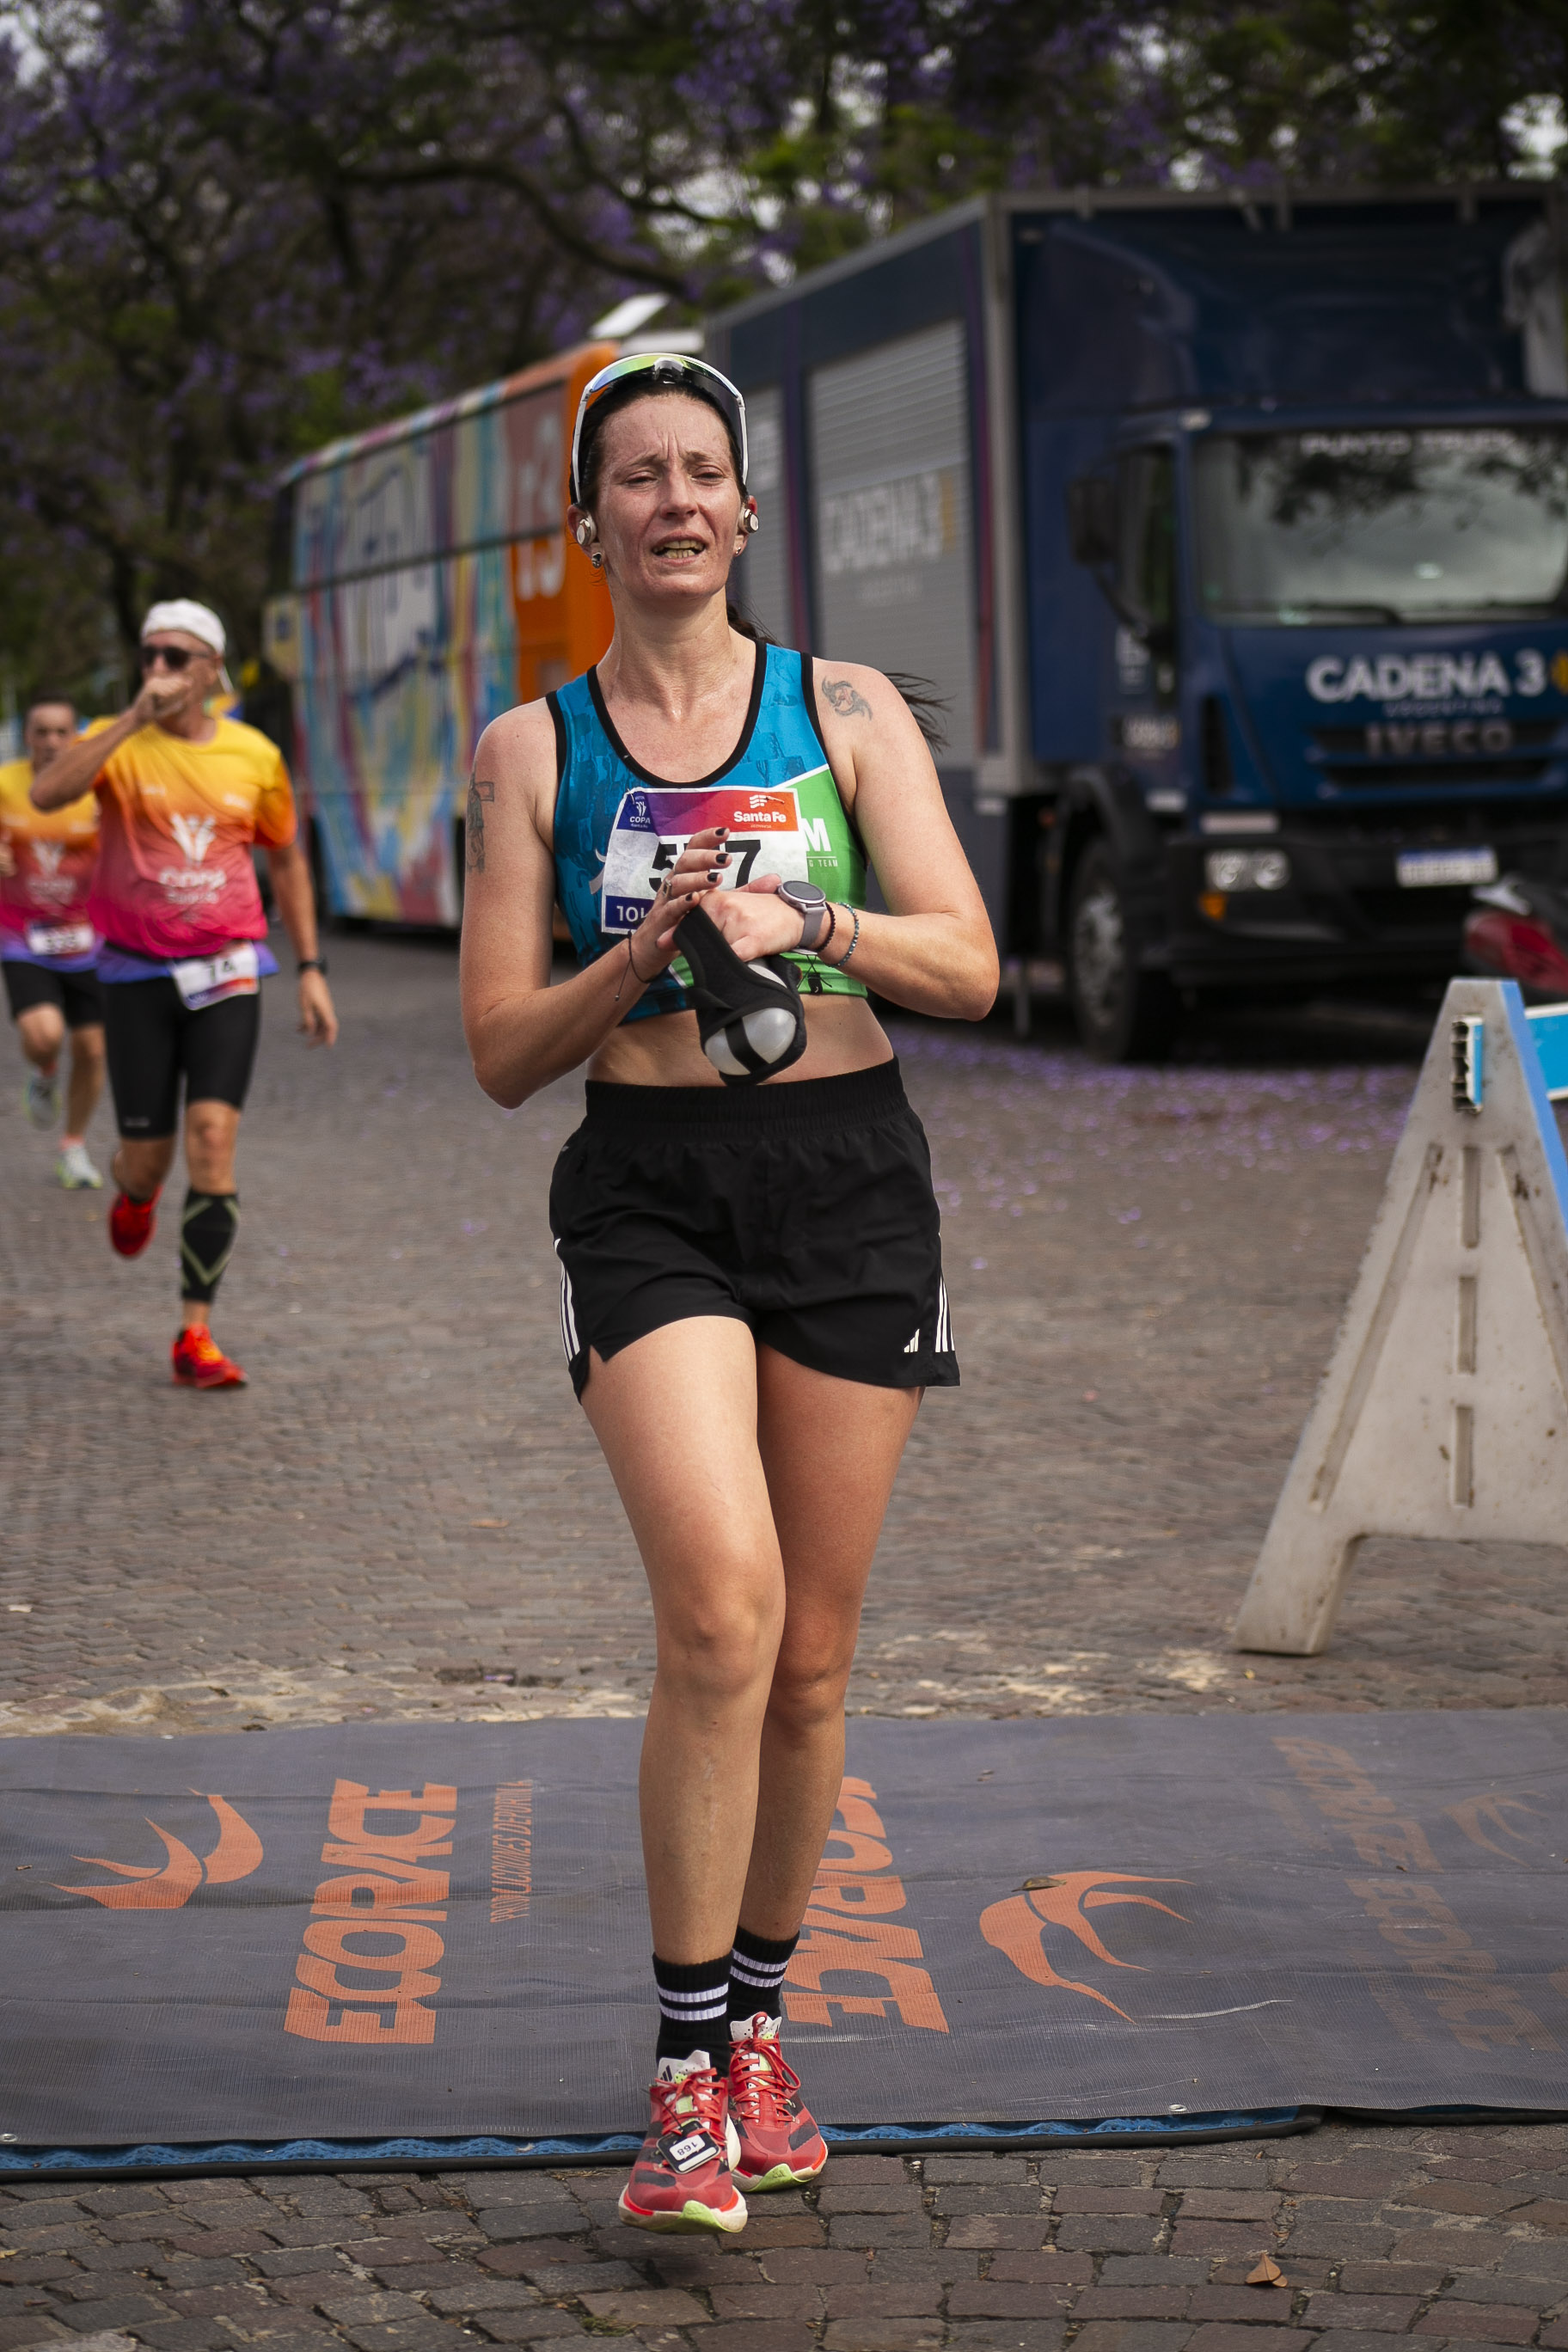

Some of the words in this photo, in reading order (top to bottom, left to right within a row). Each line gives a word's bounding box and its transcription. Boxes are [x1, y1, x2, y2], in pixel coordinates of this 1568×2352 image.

[1306, 652, 1511, 703] CADENA
[1515, 648, 1547, 697] 3
[1365, 720, 1513, 757] IVECO
[629, 816, 651, 824] COPA
[648, 839, 762, 893] 57
[284, 1778, 457, 2043] ECORACE
[677, 2141, 699, 2156] 168
